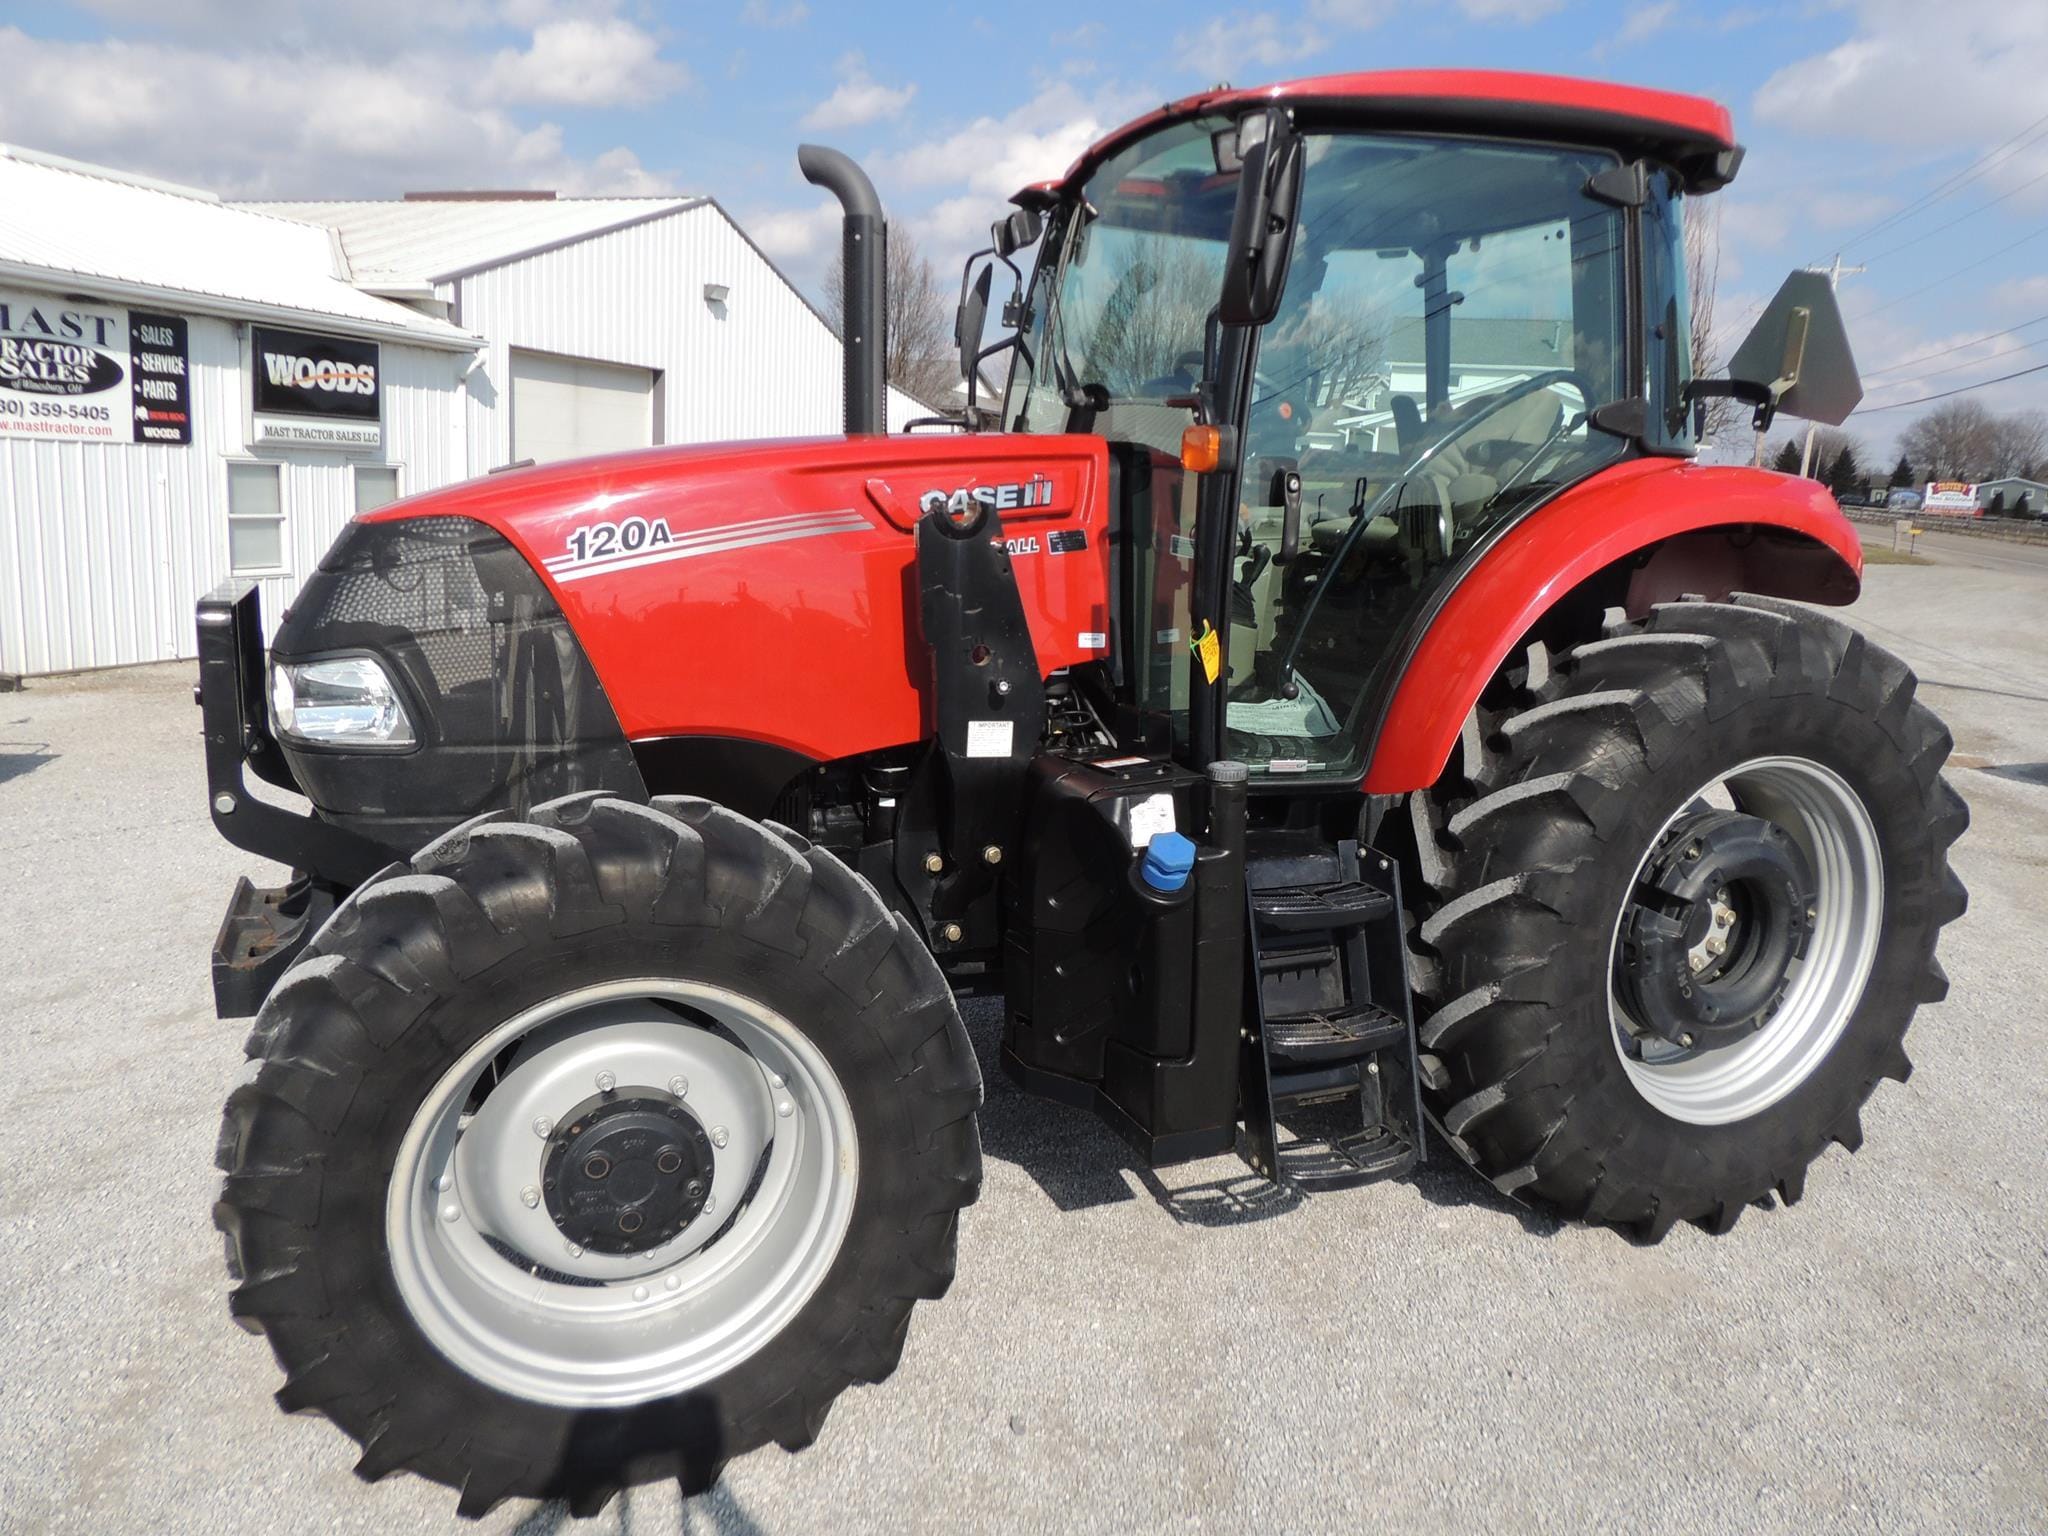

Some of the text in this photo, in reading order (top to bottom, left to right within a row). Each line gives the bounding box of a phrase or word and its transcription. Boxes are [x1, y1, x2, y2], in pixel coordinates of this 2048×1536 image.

[140, 323, 174, 347] SALES
[0, 337, 97, 369] RACTOR
[141, 351, 186, 376] SERVICE
[263, 352, 376, 395] WOODS
[142, 379, 178, 402] PARTS
[29, 401, 110, 421] 359-5405
[0, 420, 113, 437] w.masttractor.com
[143, 426, 181, 440] WOODS
[264, 425, 378, 443] MAST TRACTOR SALES LLC
[919, 485, 1019, 513] CASE
[566, 515, 673, 562] 120A
[1006, 536, 1041, 556] ALL
